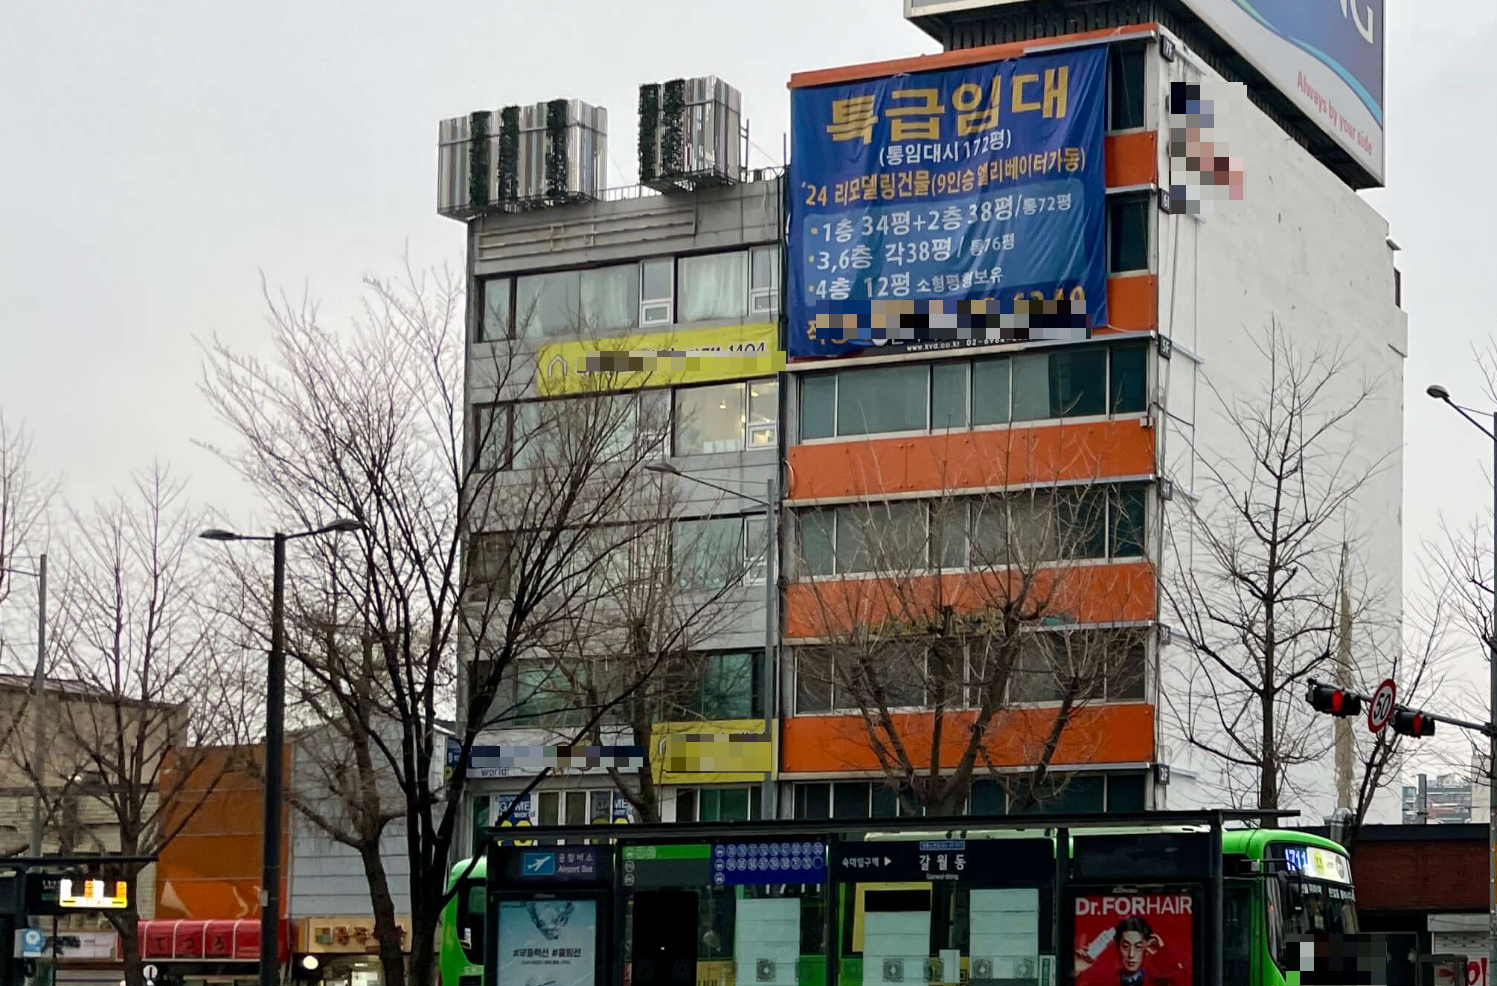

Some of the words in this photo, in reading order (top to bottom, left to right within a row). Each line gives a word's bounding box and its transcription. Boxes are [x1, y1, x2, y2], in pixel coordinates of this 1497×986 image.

[827, 66, 1069, 144] 특급임대
[1297, 71, 1327, 114] Always
[1329, 100, 1338, 126] by
[1339, 116, 1356, 140] your
[879, 141, 959, 167] (통임대시
[964, 129, 1012, 159] 172평)
[823, 218, 854, 243] 1층
[817, 244, 873, 273] 3,6층
[885, 236, 952, 266] 각38평
[815, 276, 851, 300] 4층
[863, 271, 911, 298] 12평
[1373, 693, 1391, 721] 50
[919, 854, 966, 871] 갈월동
[1075, 896, 1193, 916] Dr.FORHAIR
